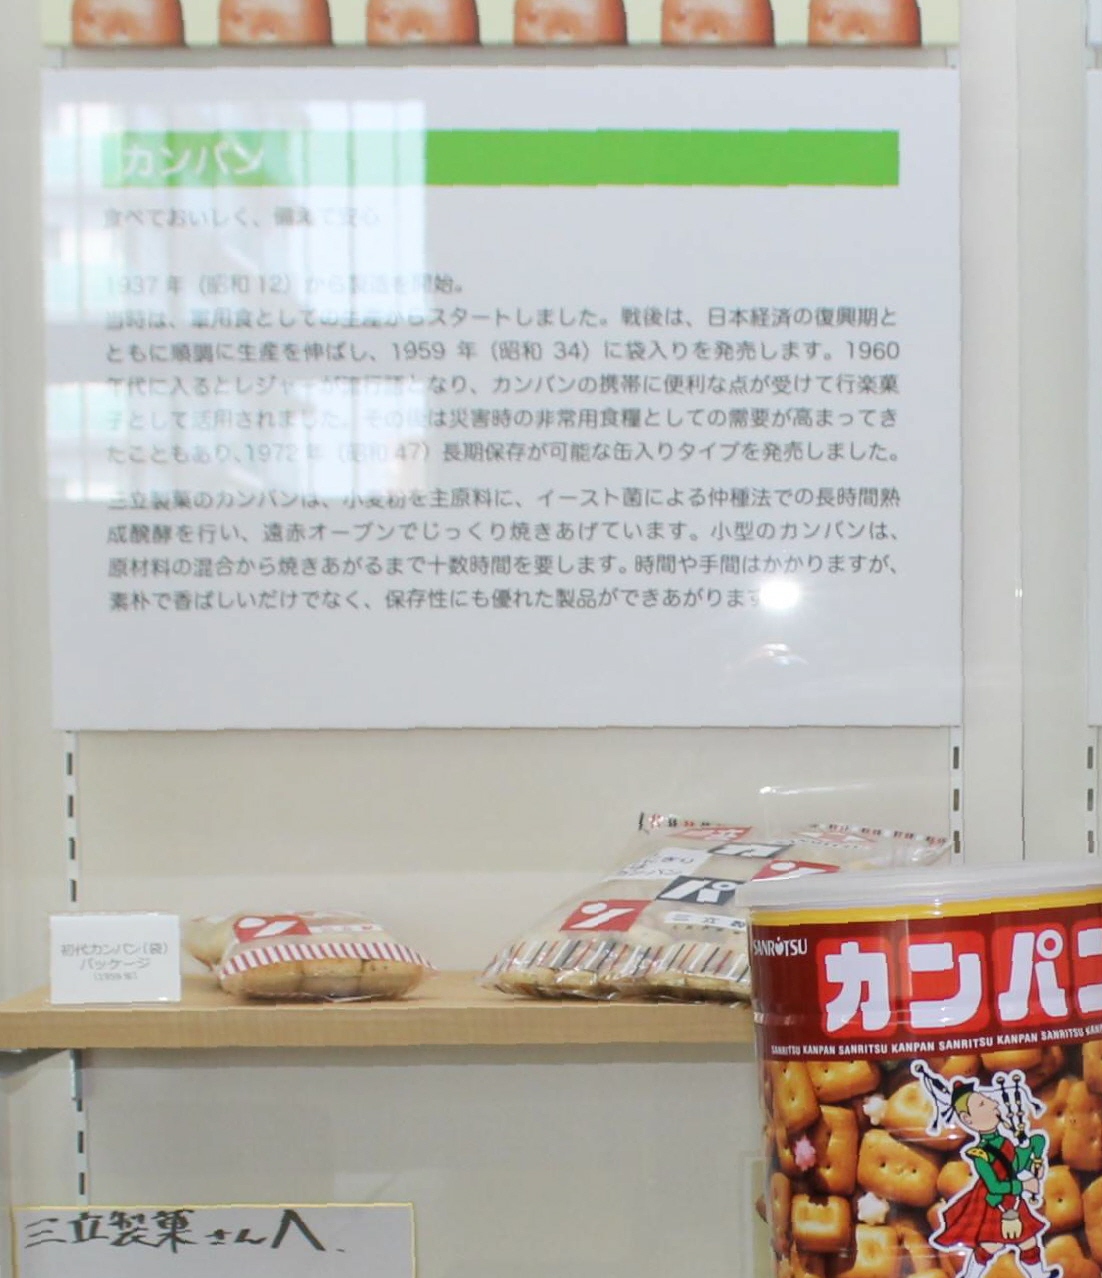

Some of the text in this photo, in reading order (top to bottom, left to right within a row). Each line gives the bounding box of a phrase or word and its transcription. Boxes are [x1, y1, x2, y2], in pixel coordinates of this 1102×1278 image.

[124, 140, 265, 177] カンパン
[803, 1044, 836, 1055] KANPAN
[838, 1042, 888, 1056] SANRITSU
[891, 1040, 935, 1054] KANPAN
[939, 1034, 993, 1051] SANRITSU
[997, 1032, 1038, 1046] KANPAN
[1041, 1026, 1084, 1042] SANRITSU
